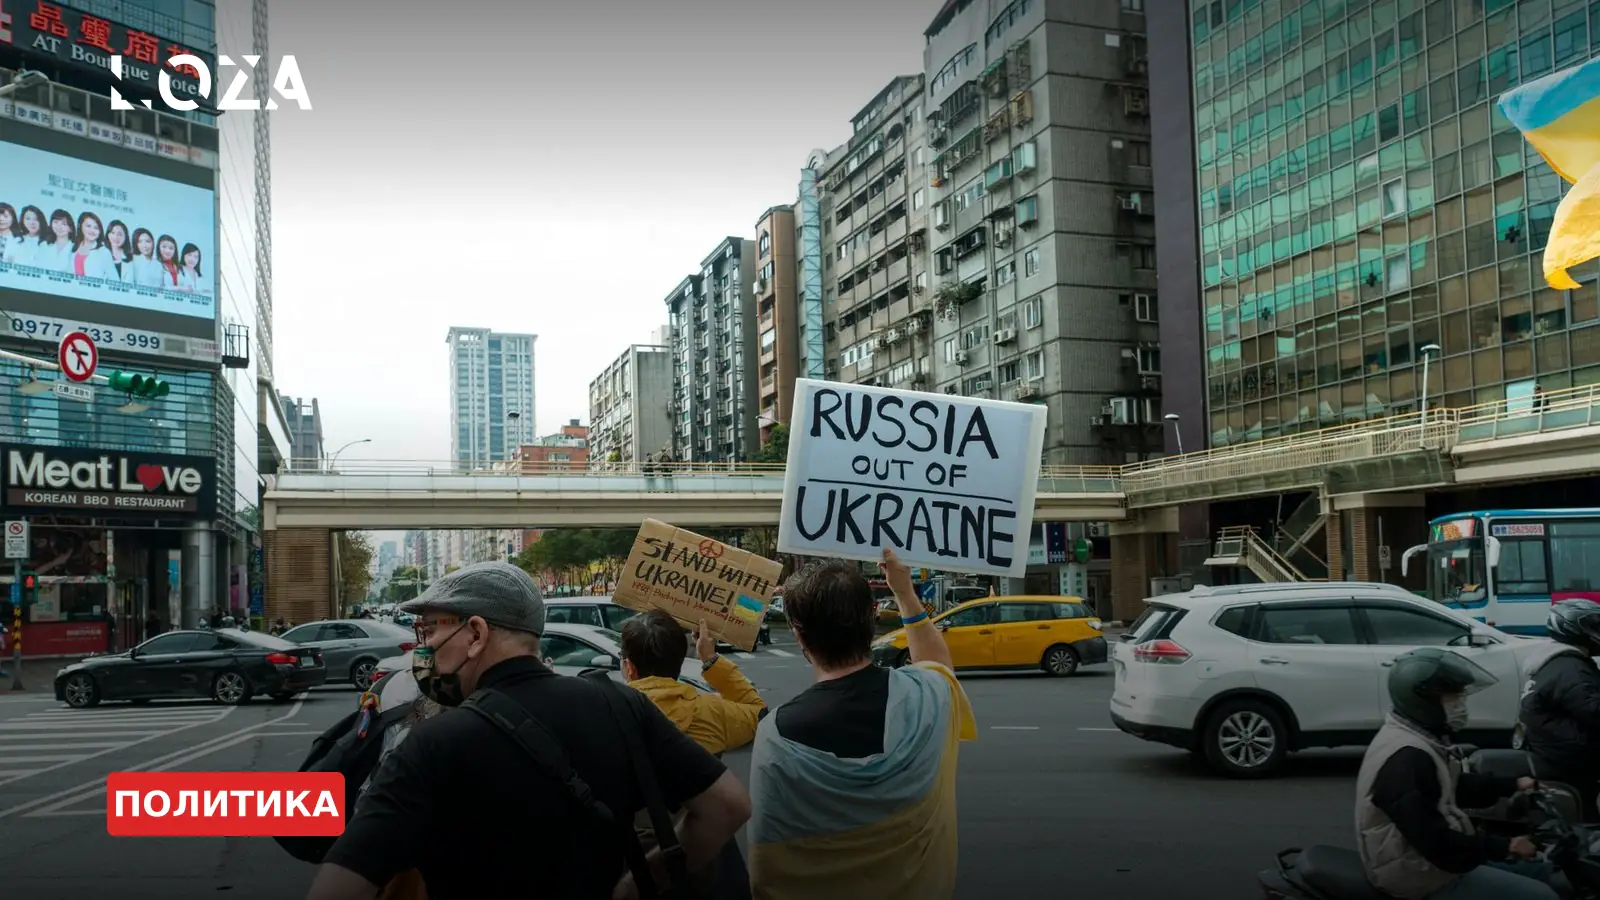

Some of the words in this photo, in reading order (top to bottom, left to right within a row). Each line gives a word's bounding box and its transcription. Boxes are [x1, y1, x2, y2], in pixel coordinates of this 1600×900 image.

[32, 33, 61, 54] AT
[71, 43, 150, 79] Boutque
[168, 74, 202, 97] ote
[810, 389, 999, 460] RUSSIA
[9, 451, 114, 489] Meat
[852, 455, 914, 481] OUT
[926, 462, 967, 487] OF
[25, 492, 77, 504] KOREAN
[83, 495, 109, 506] BBQ
[115, 497, 186, 508] RESTAURANT
[796, 486, 1016, 568] UKRAINE
[635, 560, 735, 614] UKRAINE!
[642, 537, 717, 574] STAND
[718, 564, 769, 596] WITH
